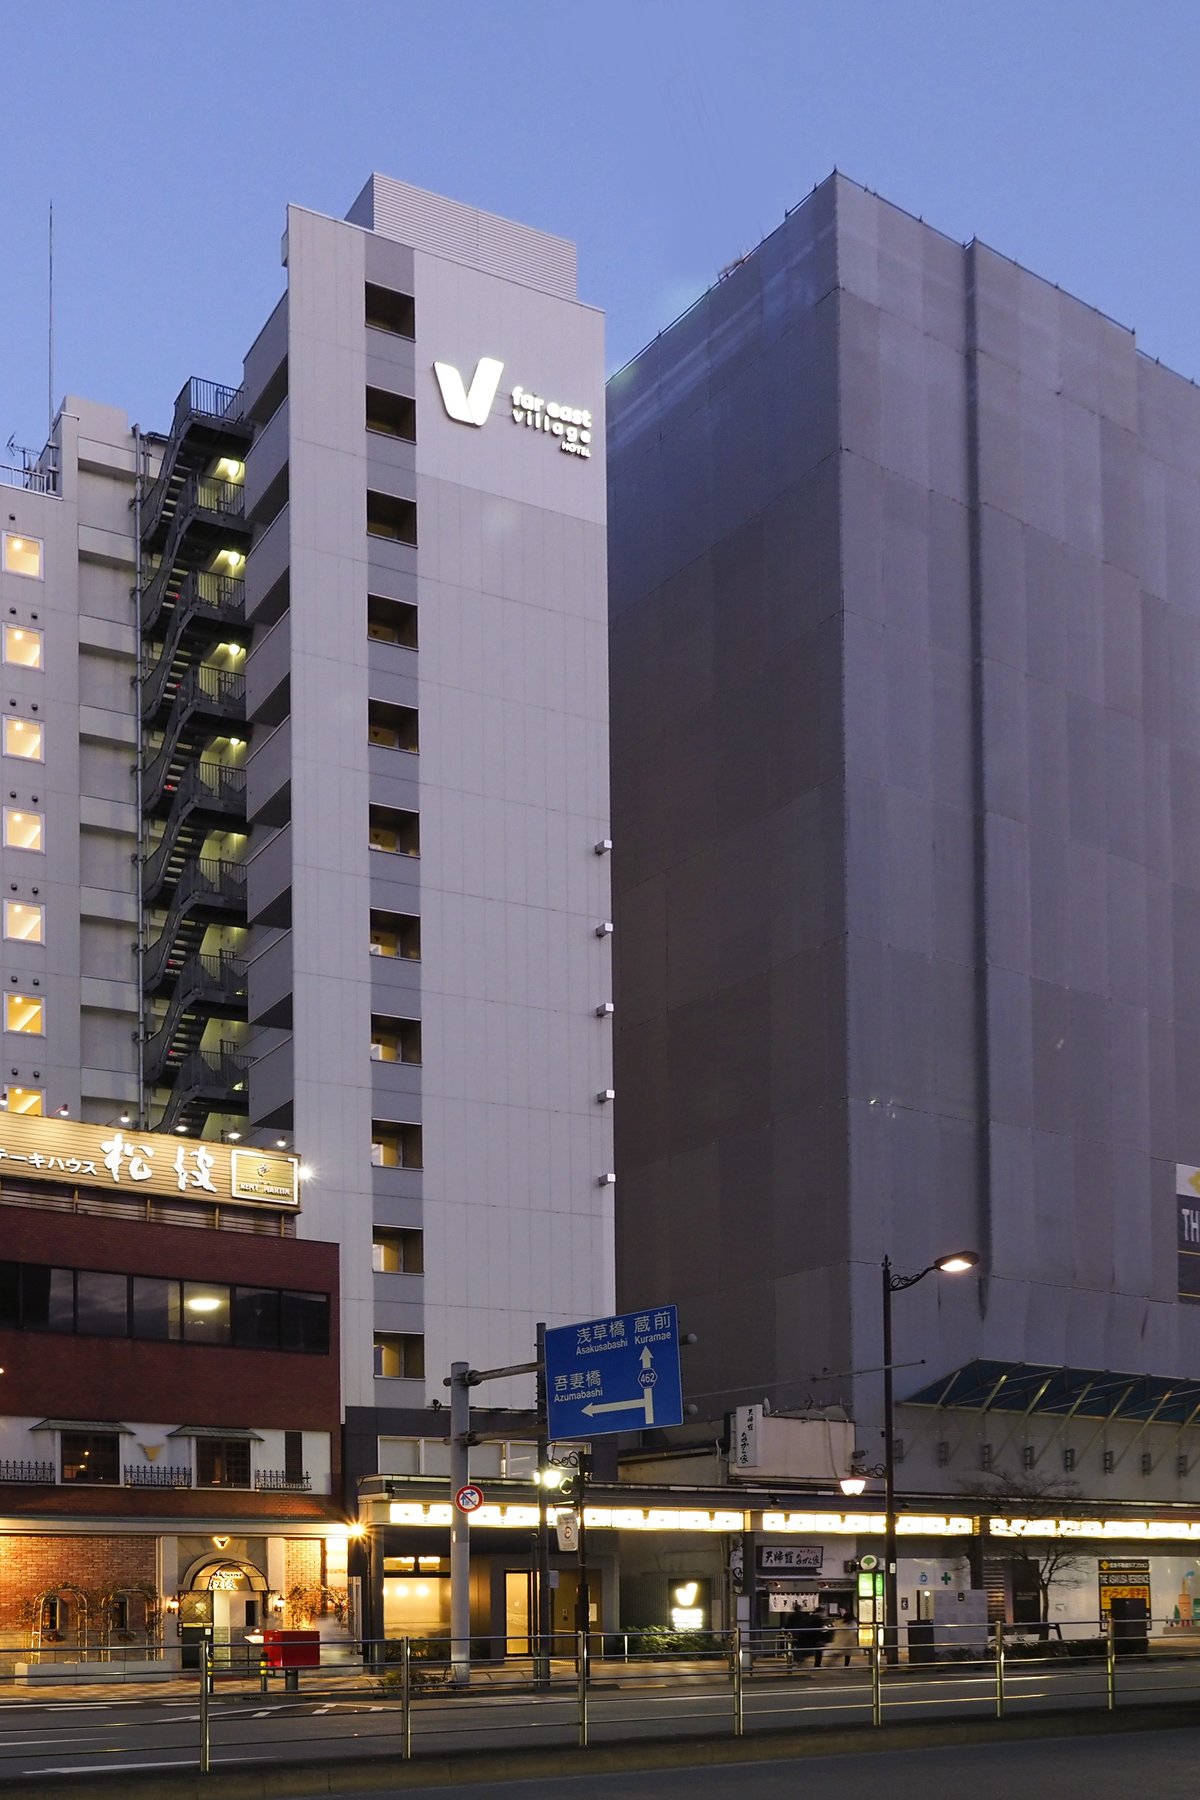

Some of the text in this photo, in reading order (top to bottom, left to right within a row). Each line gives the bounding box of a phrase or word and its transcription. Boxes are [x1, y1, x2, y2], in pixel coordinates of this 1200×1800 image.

[511, 386, 592, 428] far east
[512, 409, 591, 443] village
[561, 441, 591, 458] HOTEL
[576, 1311, 671, 1345] 浅草橋 蔵前
[576, 1332, 672, 1356] Asakusabashi Kuramae
[554, 1370, 601, 1391] 吾妻橋
[640, 1373, 655, 1384] 462
[554, 1387, 603, 1403] Azumabashi
